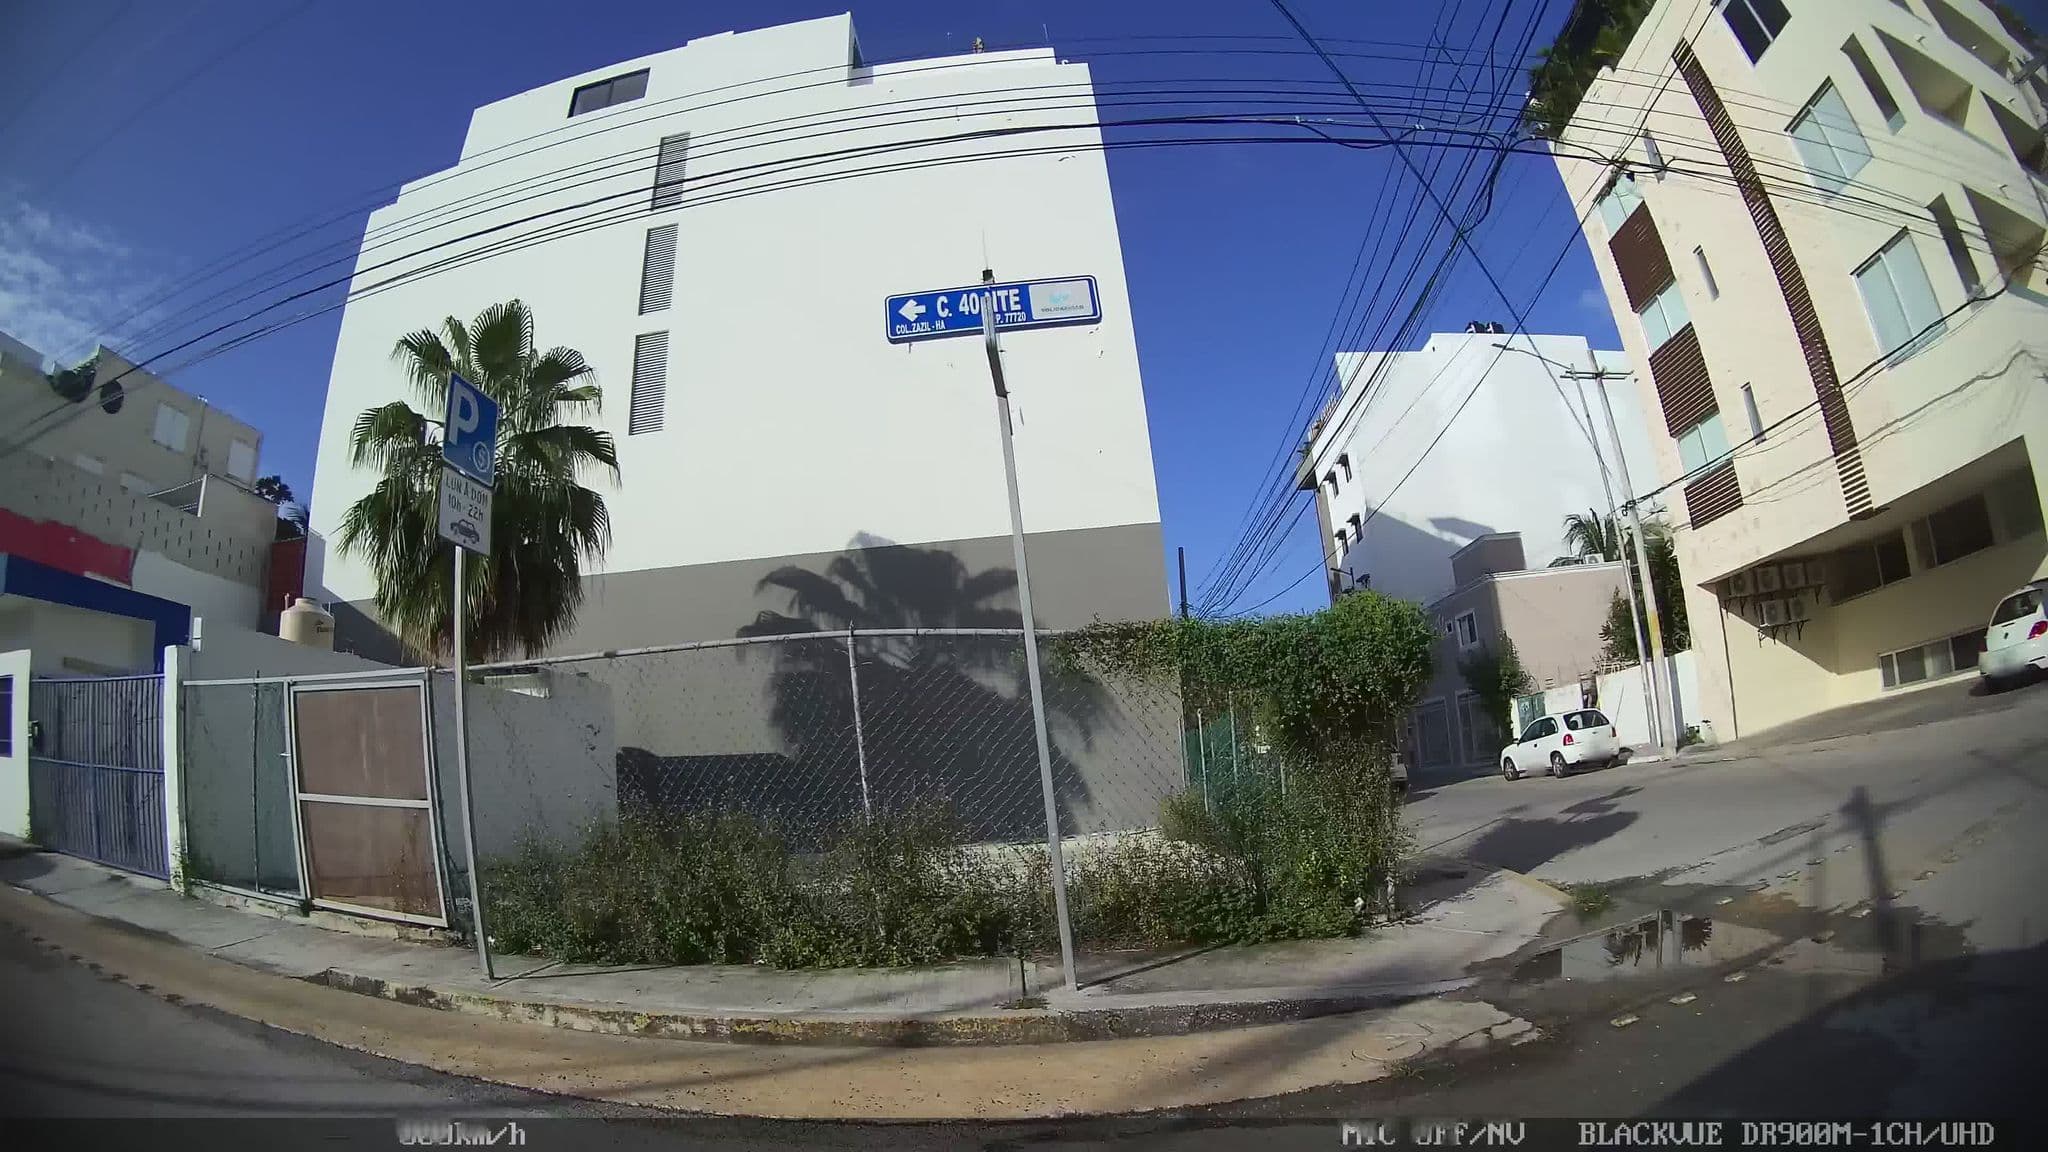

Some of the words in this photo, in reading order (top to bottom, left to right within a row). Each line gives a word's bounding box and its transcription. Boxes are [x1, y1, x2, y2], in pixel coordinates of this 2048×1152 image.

[936, 296, 953, 318] C.
[959, 292, 980, 315] 40
[1005, 311, 1026, 323] 77720
[449, 381, 480, 446] P
[468, 503, 484, 521] 22h
